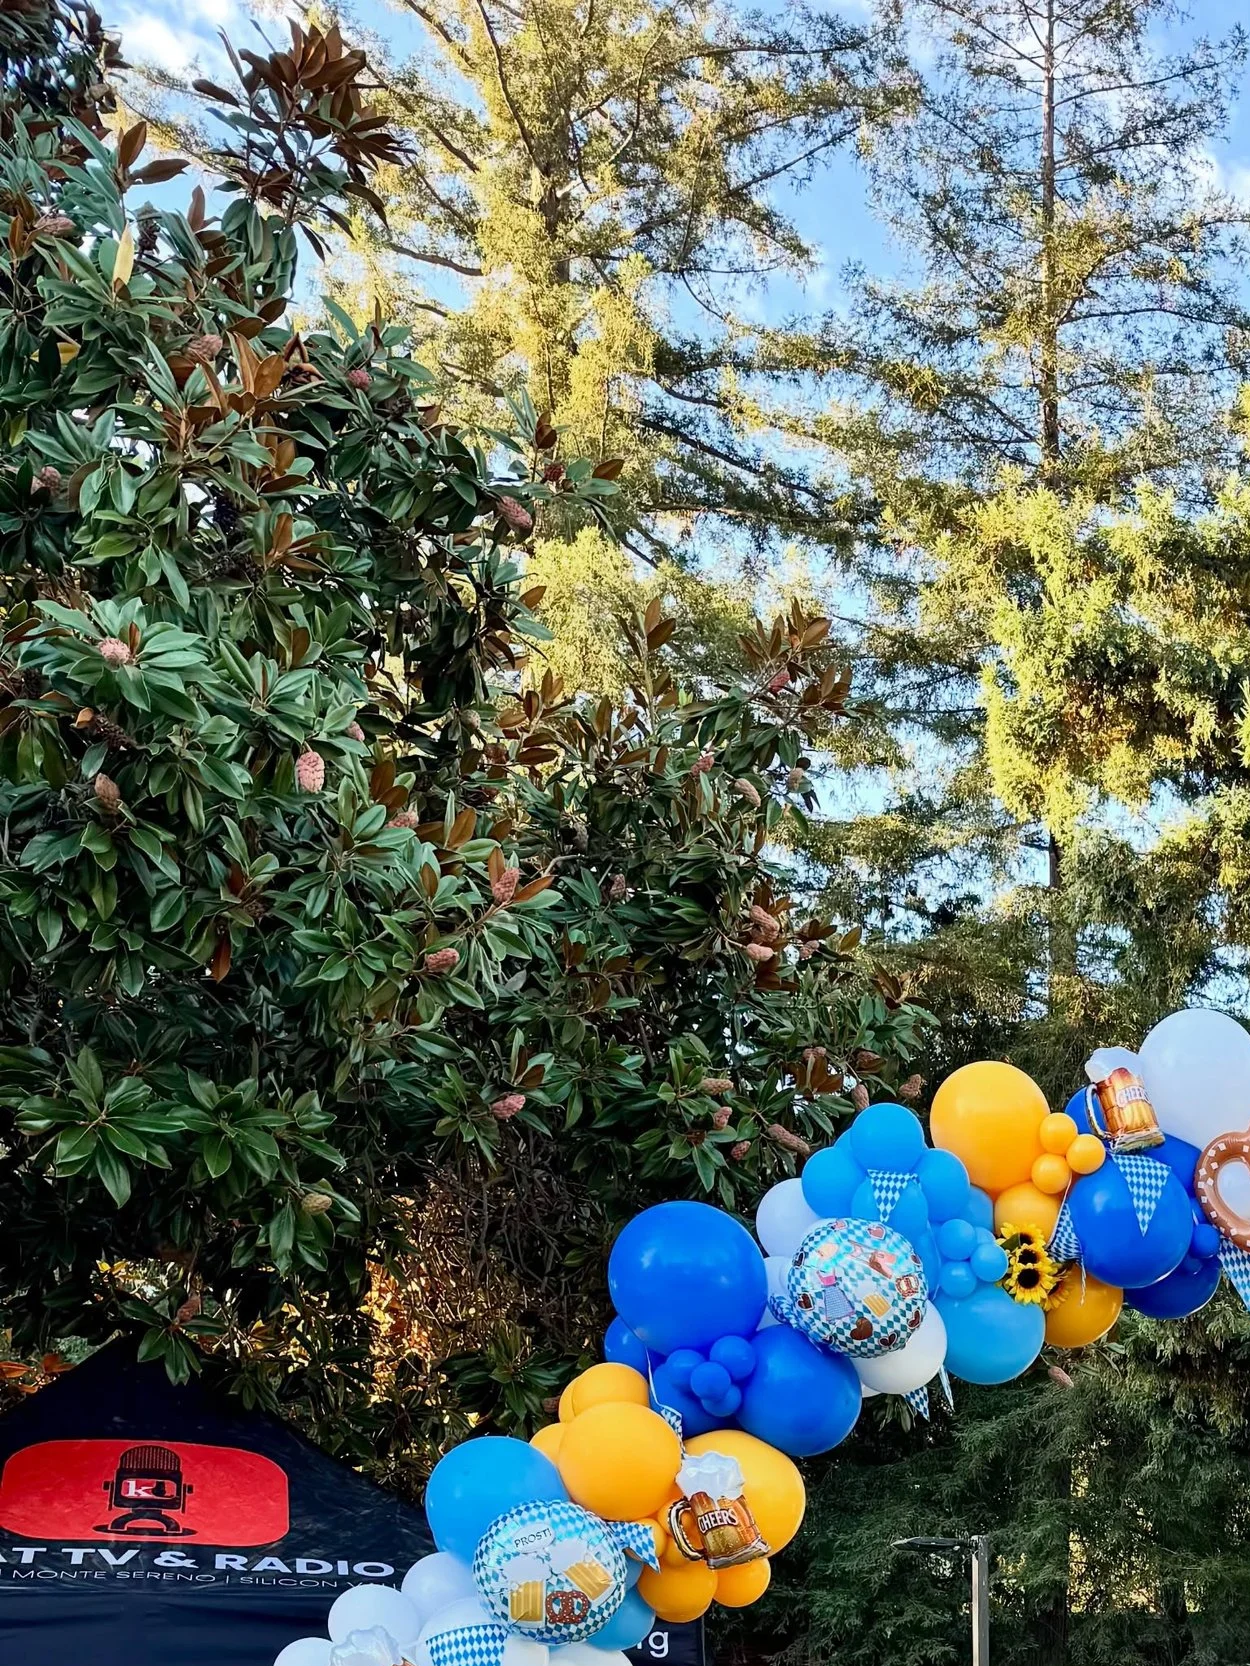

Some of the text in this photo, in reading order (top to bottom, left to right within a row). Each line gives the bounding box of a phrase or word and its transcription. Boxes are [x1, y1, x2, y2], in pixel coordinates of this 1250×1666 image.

[698, 1508, 738, 1534] CHEERS
[514, 1527, 552, 1549] PROST!
[61, 1548, 140, 1566] TV
[153, 1550, 200, 1569] &
[214, 1553, 395, 1577] RADIO
[12, 1569, 107, 1579] MONTE
[116, 1570, 216, 1582] SERENO
[240, 1576, 338, 1588] SILICON
